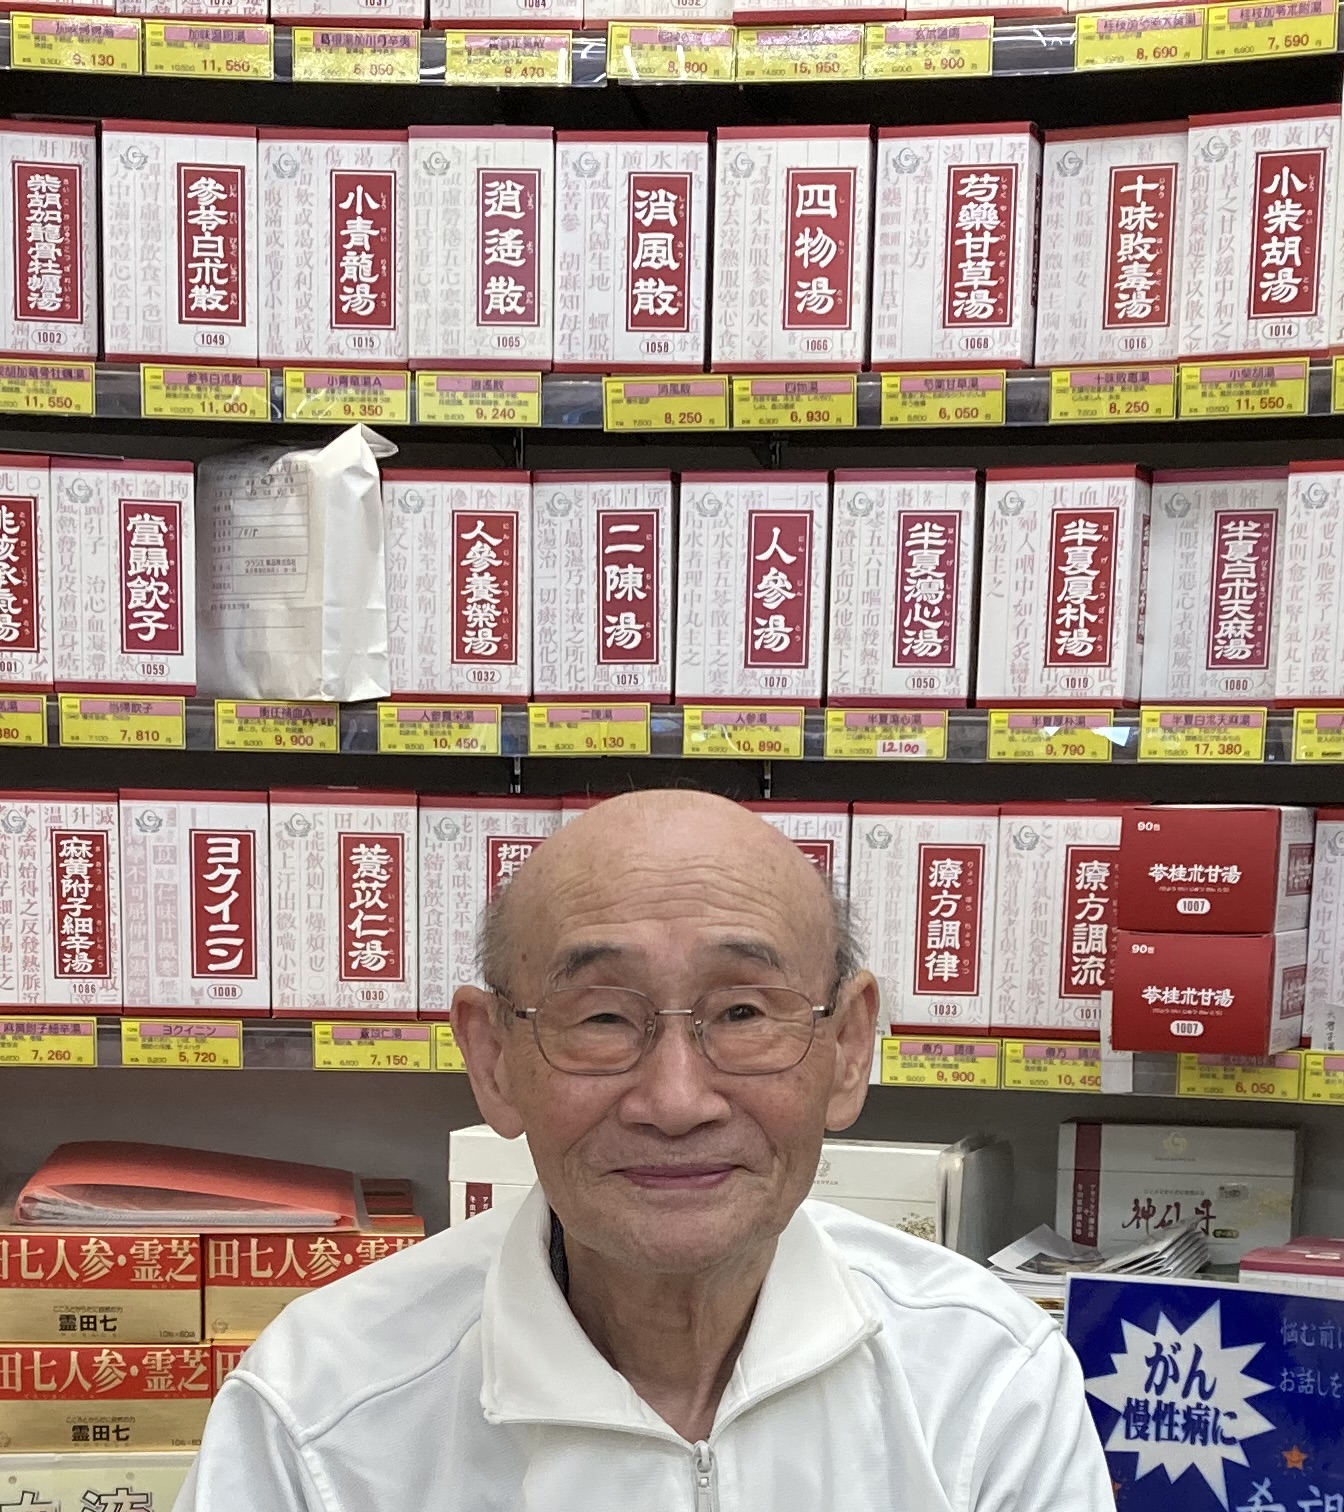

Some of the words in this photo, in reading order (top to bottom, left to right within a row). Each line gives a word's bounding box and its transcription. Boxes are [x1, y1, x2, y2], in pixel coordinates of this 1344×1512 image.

[1269, 324, 1293, 337] 1014
[200, 333, 225, 347] 1049
[142, 664, 164, 675] 1059
[911, 677, 935, 689] 1050
[1182, 900, 1203, 912] 1007
[58, 1314, 117, 1334] 霊田七
[1144, 1342, 1218, 1396] がん
[1123, 1404, 1241, 1448] 慢性病に
[72, 1424, 130, 1443] 霊田七
